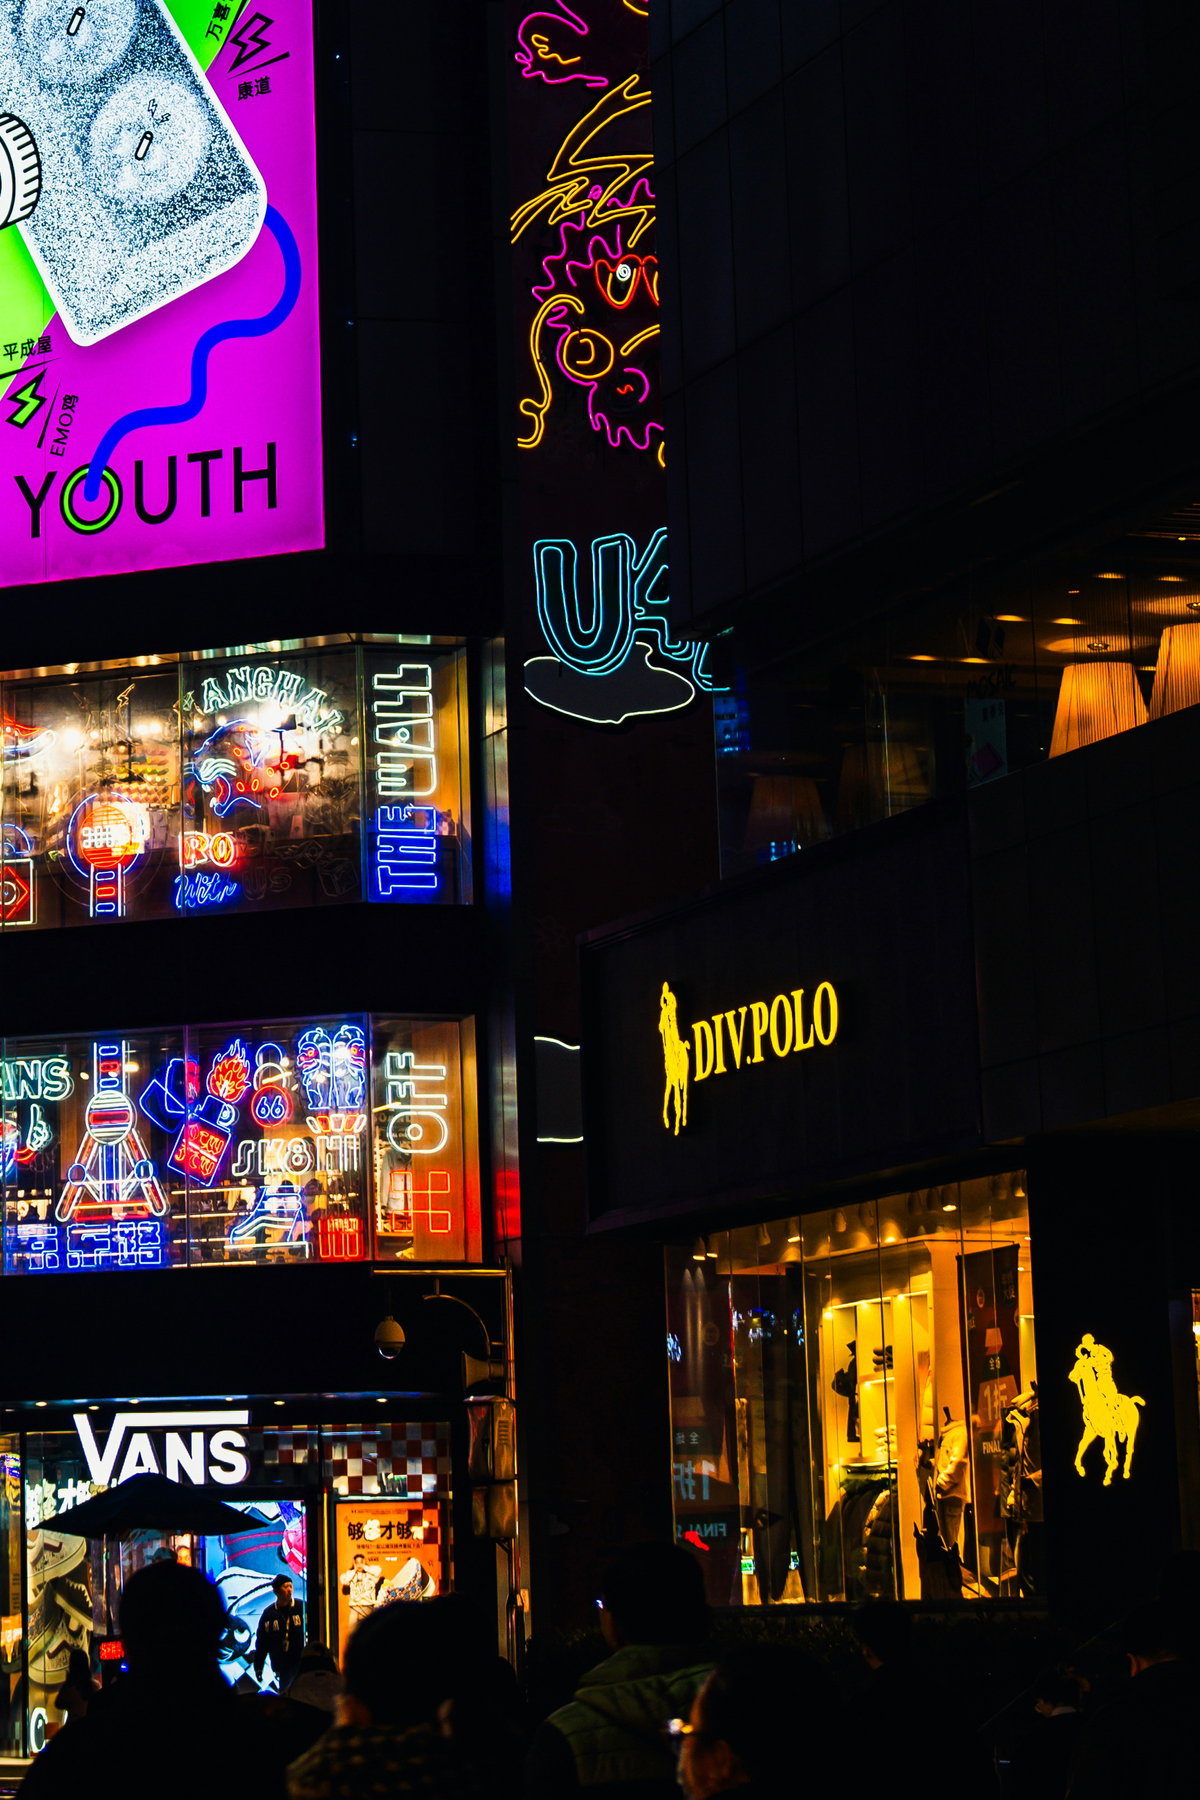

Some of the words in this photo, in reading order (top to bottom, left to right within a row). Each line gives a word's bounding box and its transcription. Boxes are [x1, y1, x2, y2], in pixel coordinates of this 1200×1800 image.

[237, 75, 272, 102] 康道
[2, 335, 53, 362] 平成屋
[49, 393, 79, 457] EMO鸡
[13, 441, 277, 539] YOUTH
[373, 664, 437, 796] WALL
[377, 805, 438, 895] THE
[692, 981, 838, 1082] DIV.POLO
[255, 1096, 285, 1120] 66
[386, 1053, 448, 1154] OFF
[72, 1410, 249, 1485] VANS
